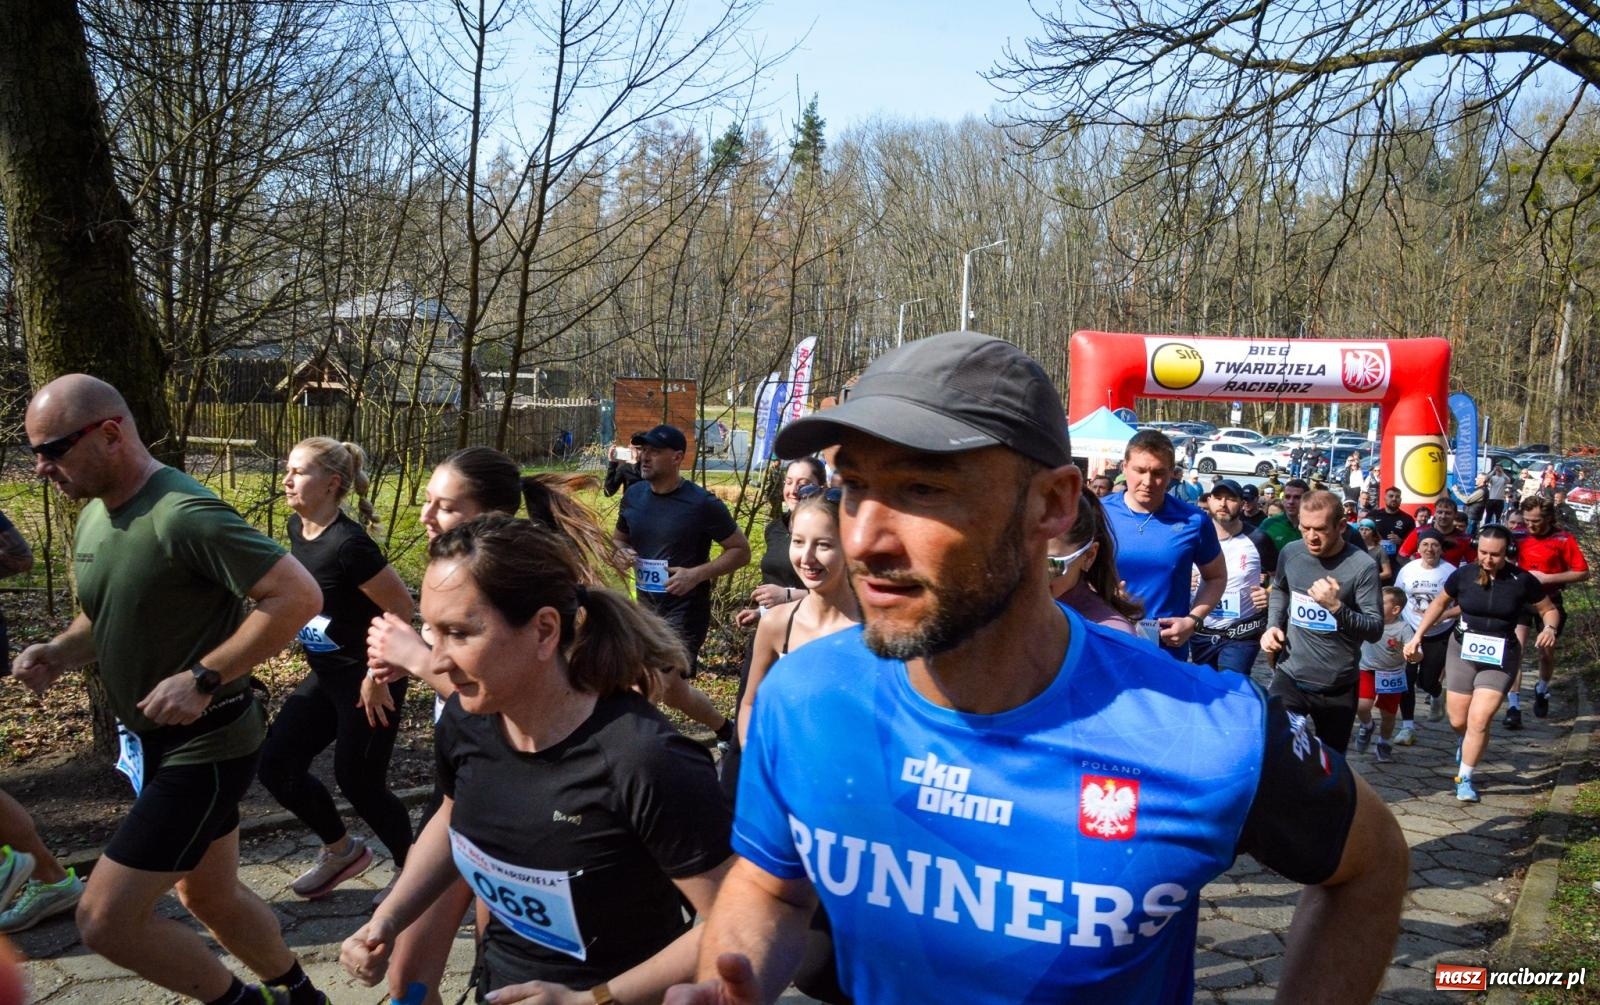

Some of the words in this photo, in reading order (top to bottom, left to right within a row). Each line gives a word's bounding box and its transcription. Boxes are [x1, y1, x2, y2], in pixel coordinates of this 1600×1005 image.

[1248, 345, 1290, 356] BIEG
[1214, 361, 1327, 376] TWARDZIELA
[1223, 379, 1314, 394] RACIBÓRZ
[637, 568, 661, 583] 078
[1297, 605, 1328, 622] 009
[1469, 643, 1496, 656] 020
[1381, 677, 1403, 689] 065
[1081, 759, 1142, 776] POLAND
[916, 785, 1014, 827] okna
[787, 812, 1190, 949] RUNNERS
[473, 870, 552, 928] 068
